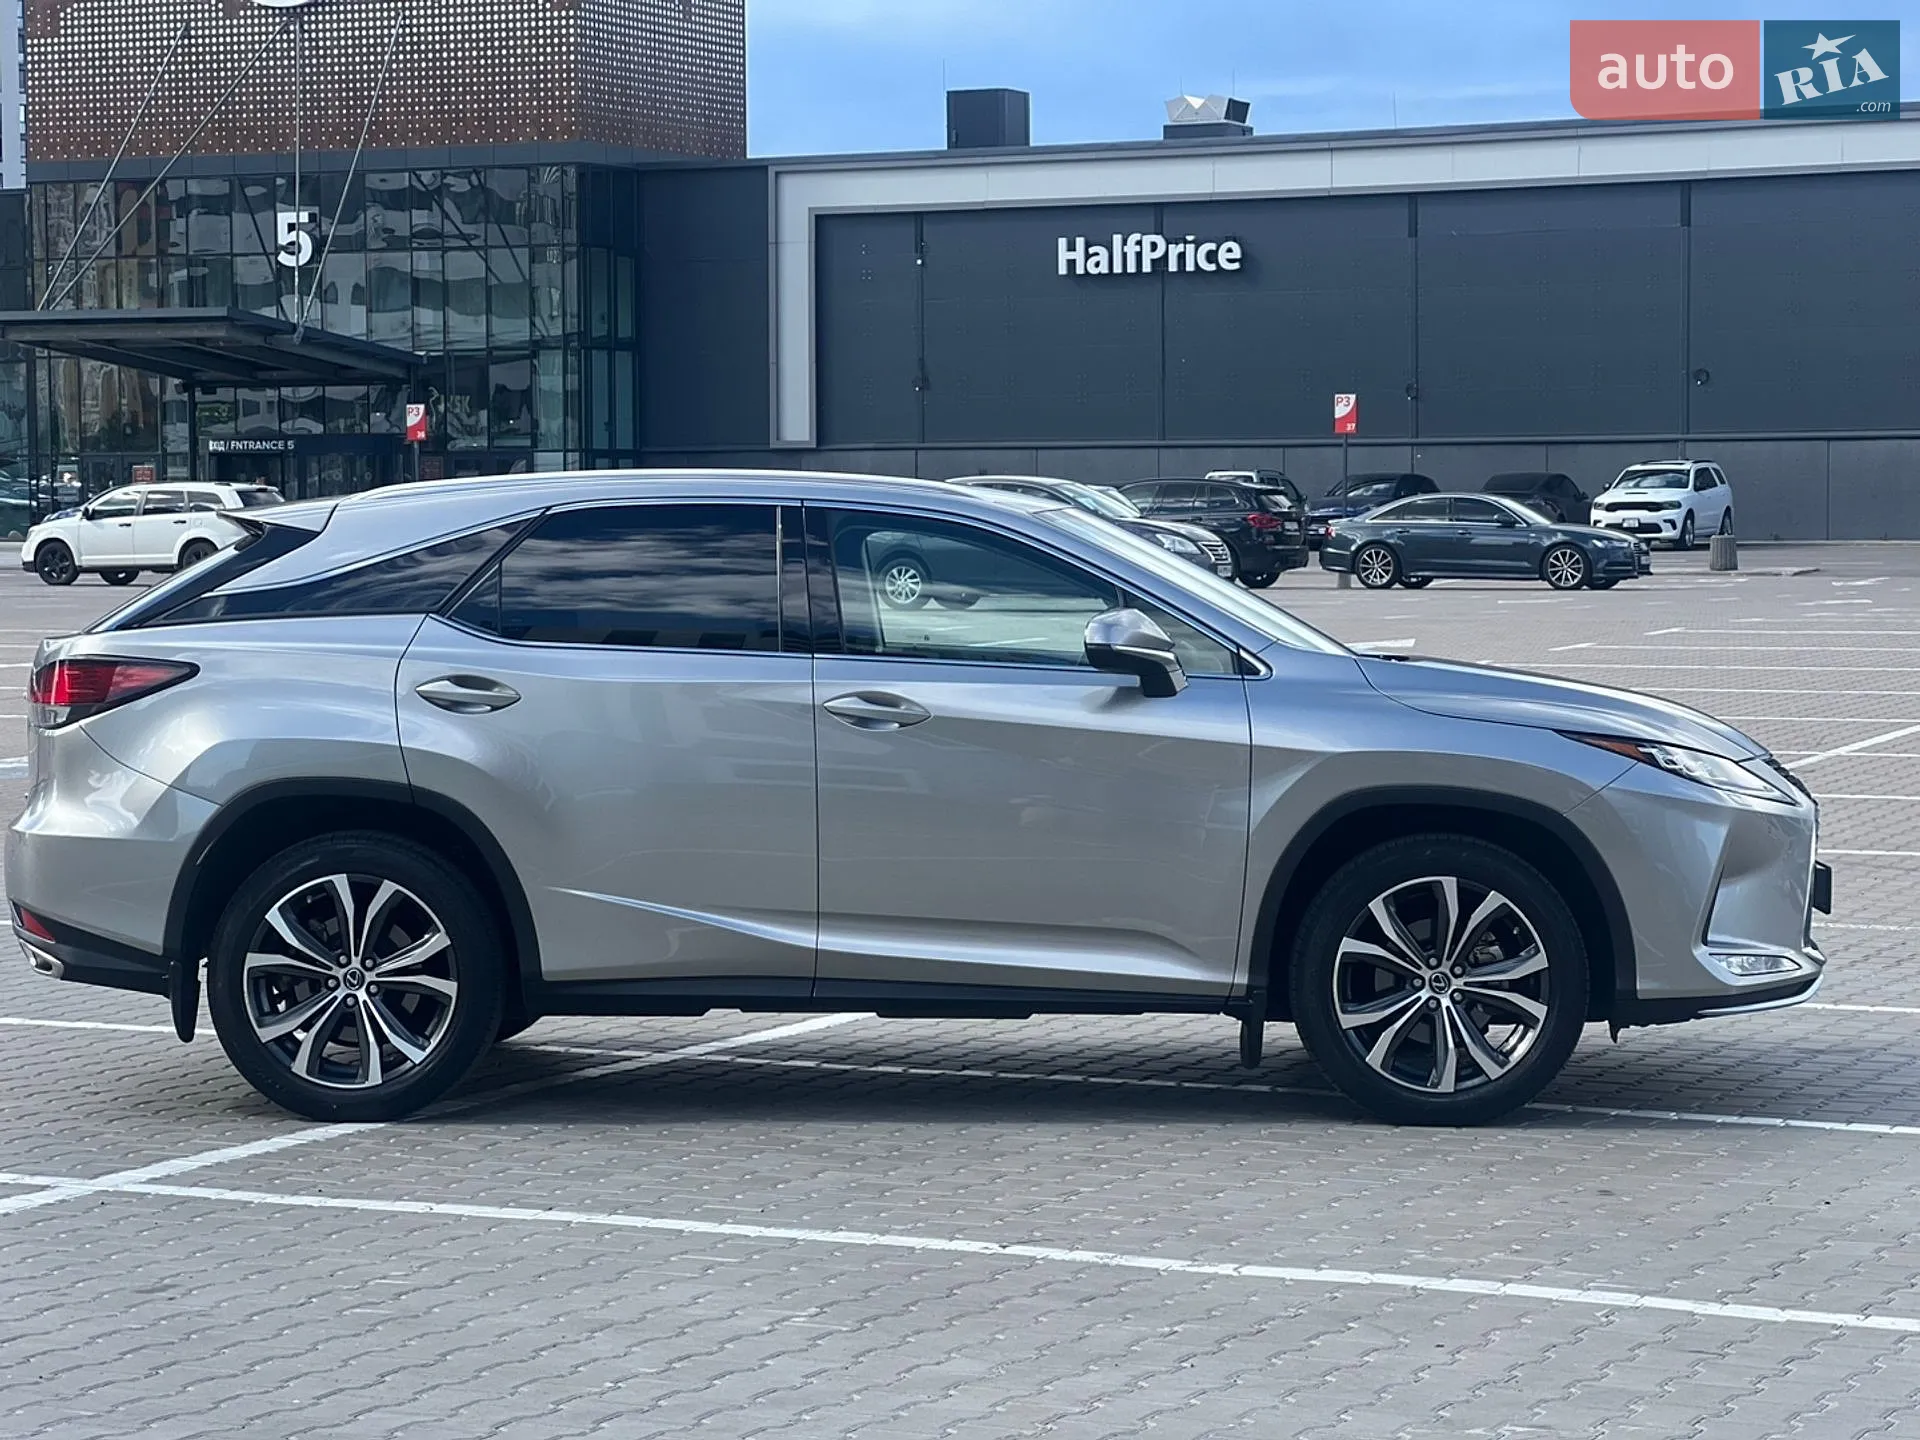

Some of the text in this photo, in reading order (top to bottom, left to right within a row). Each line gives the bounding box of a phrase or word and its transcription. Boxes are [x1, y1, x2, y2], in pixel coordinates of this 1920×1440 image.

[277, 211, 313, 267] 5
[1057, 233, 1242, 276] HalfPrice
[1336, 396, 1351, 407] P3
[407, 406, 420, 417] P3
[287, 440, 295, 450] 5
